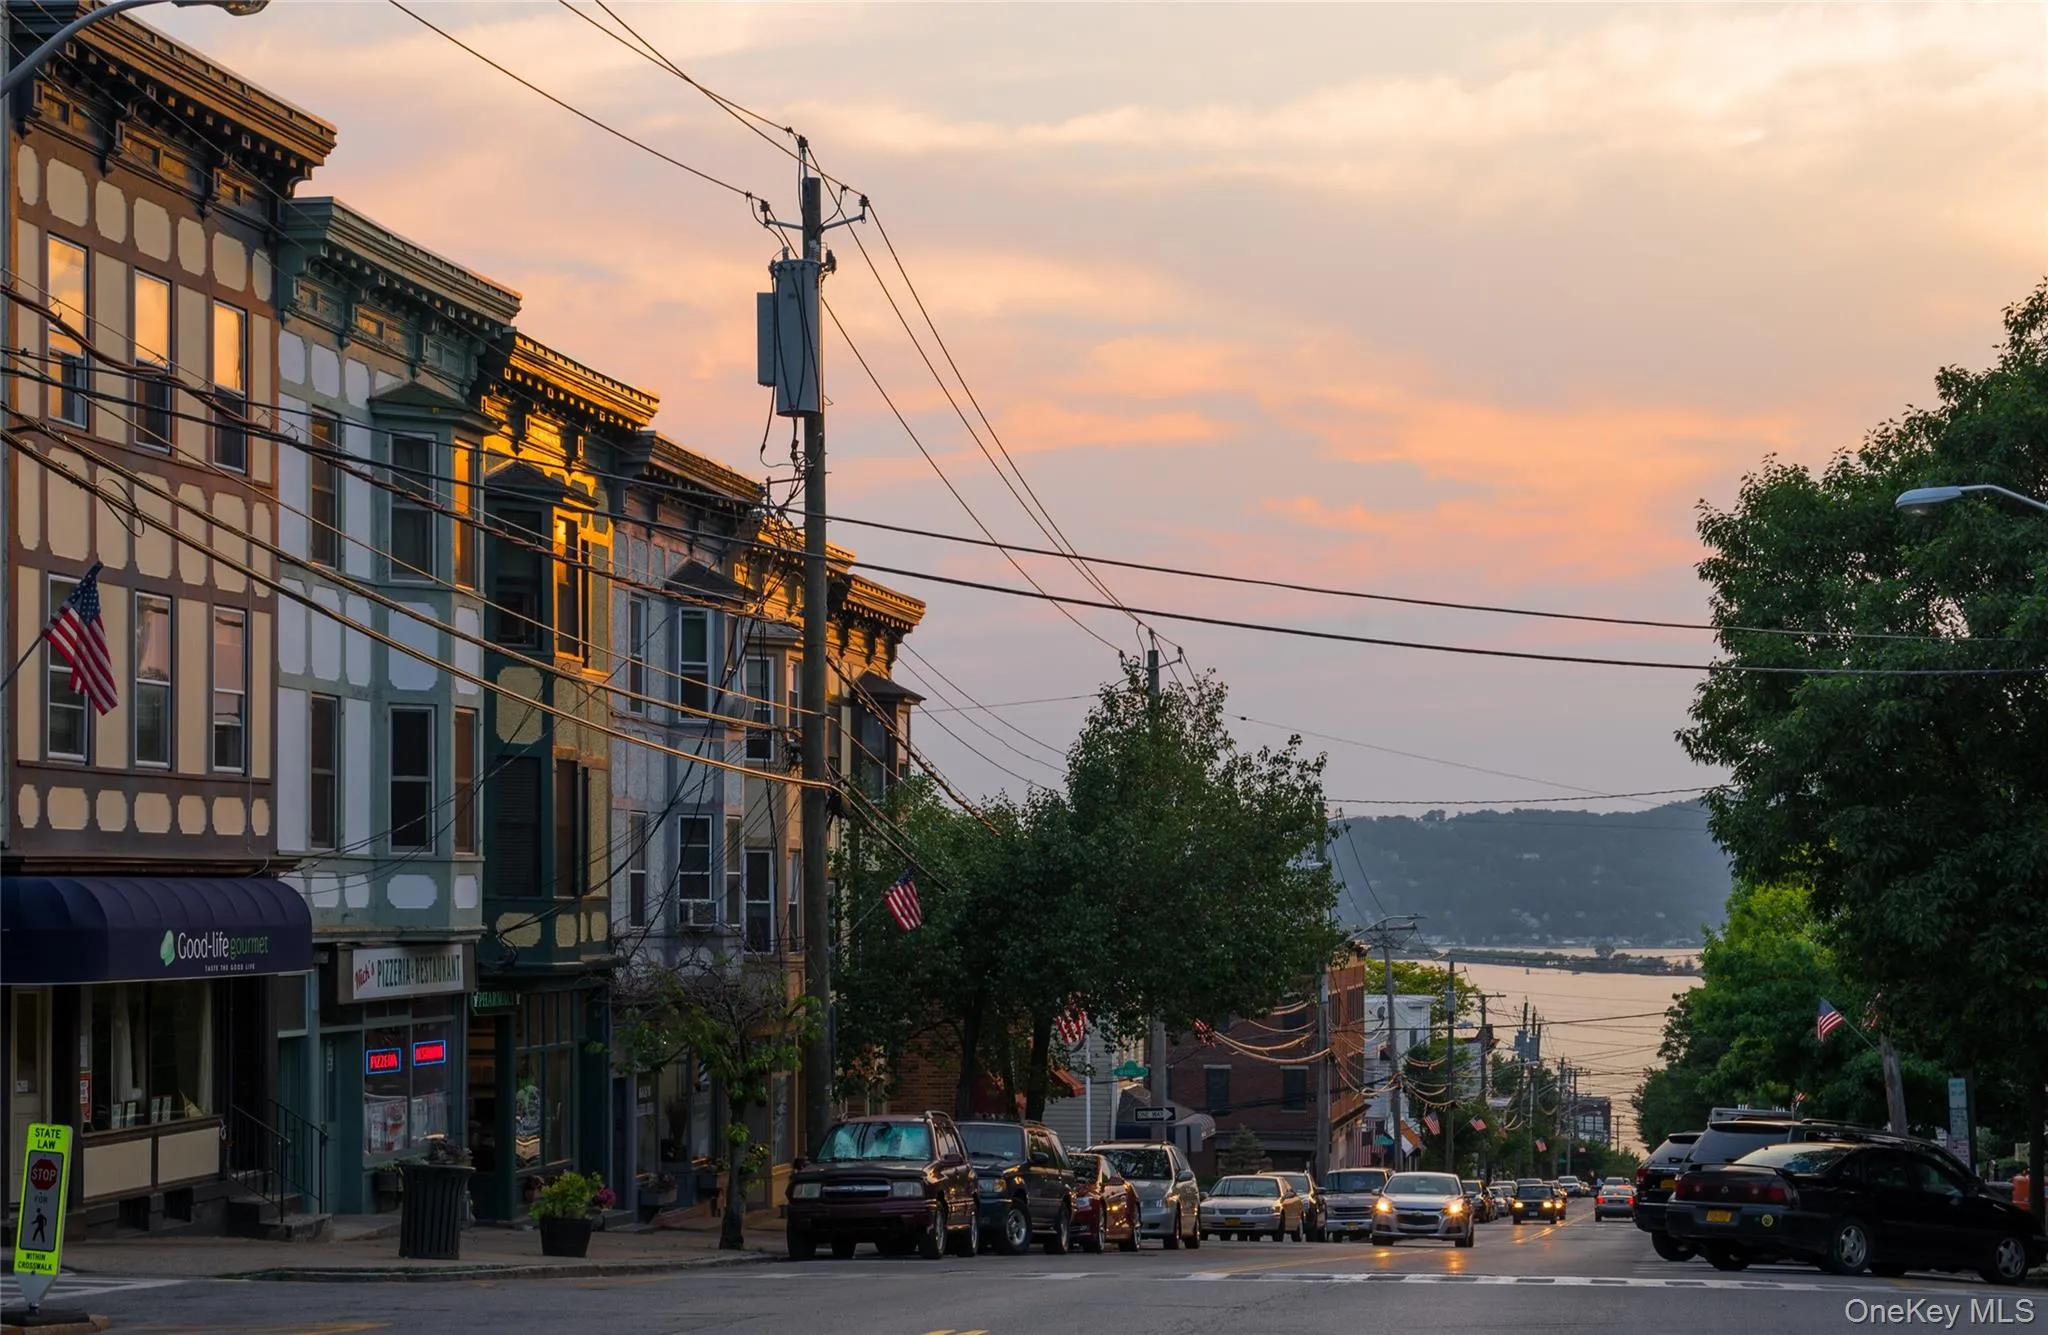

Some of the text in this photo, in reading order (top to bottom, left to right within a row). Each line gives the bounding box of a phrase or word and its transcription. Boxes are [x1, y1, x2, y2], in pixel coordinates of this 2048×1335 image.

[178, 931, 269, 961] Good-life gourmet
[354, 959, 376, 991] Nick's
[377, 958, 411, 988] PIZZERIA
[415, 954, 460, 985] RESTAURANT
[1137, 1111, 1164, 1119] ONE WAY
[34, 1127, 62, 1139] STATE
[37, 1139, 56, 1150] LAW
[31, 1168, 57, 1181] STOP
[34, 1195, 48, 1204] FOR
[26, 1253, 46, 1262] WITHIN
[17, 1260, 53, 1271] CROSSWALK
